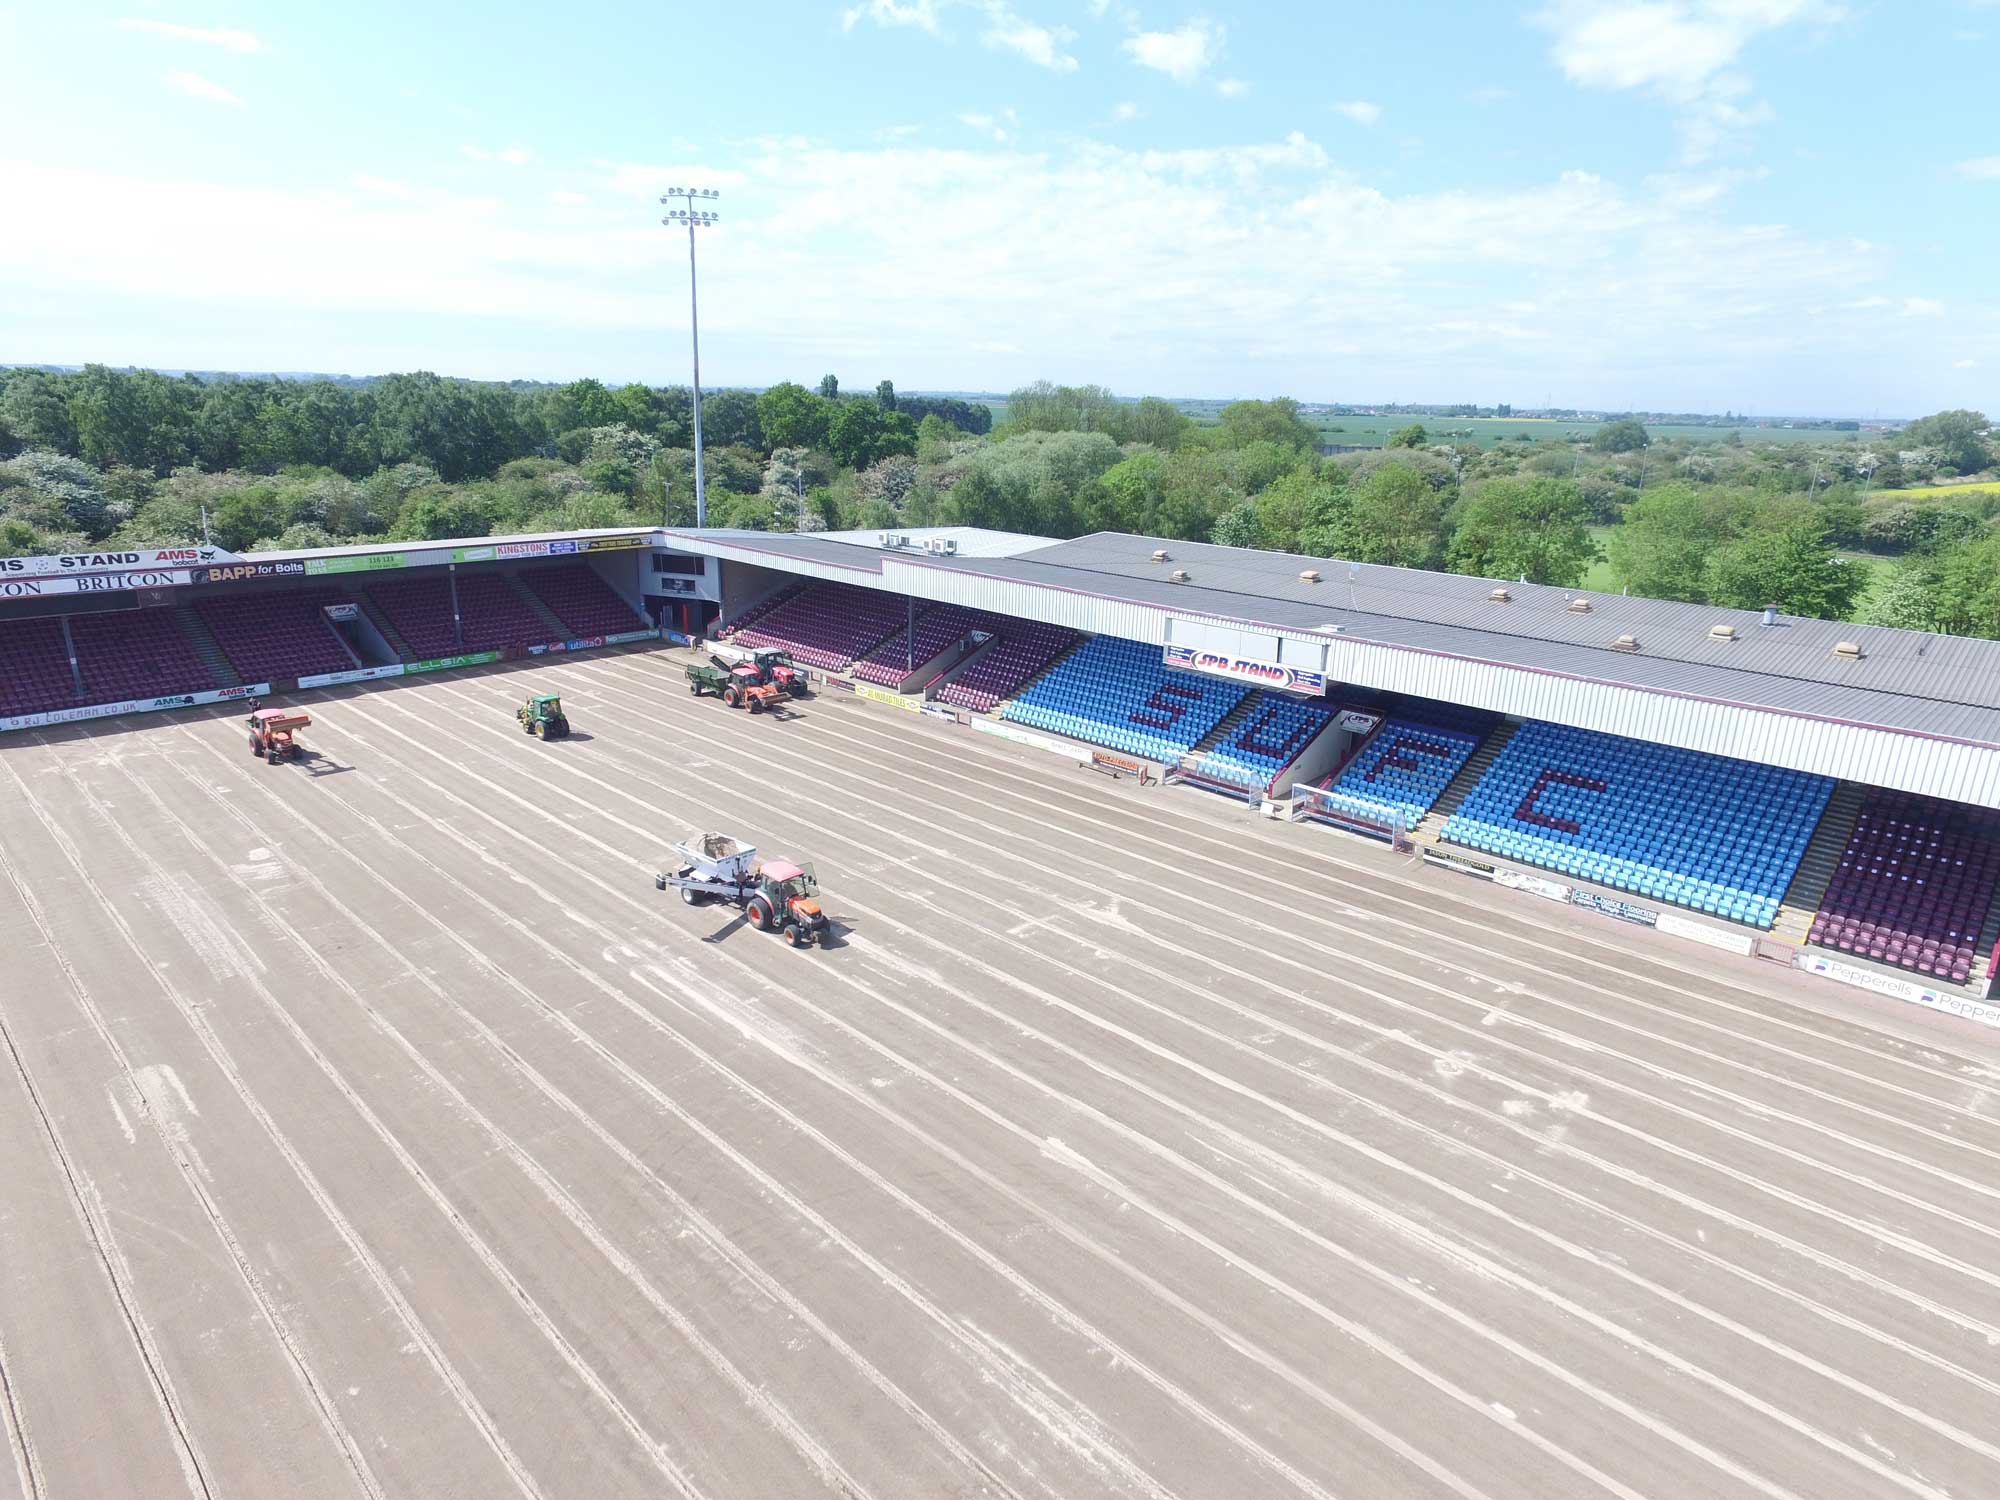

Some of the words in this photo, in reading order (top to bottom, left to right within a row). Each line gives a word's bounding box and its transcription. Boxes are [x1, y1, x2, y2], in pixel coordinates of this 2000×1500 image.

[155, 549, 198, 560] AMS
[497, 543, 548, 554] KINGSTONS
[59, 553, 140, 567] STAND
[209, 565, 256, 582] BAPP
[258, 564, 273, 574] for
[275, 563, 304, 573] Bolts
[0, 582, 41, 596] ON
[76, 572, 174, 591] BRITCON
[407, 656, 467, 671] ELLGIA
[1198, 654, 1229, 668] SPB
[1231, 660, 1285, 680] STAND
[218, 687, 245, 697] AMS
[154, 697, 183, 706] AMS
[1595, 895, 1620, 908] Choice
[1622, 902, 1657, 919] Flooring
[1832, 962, 1912, 996] Pepperells
